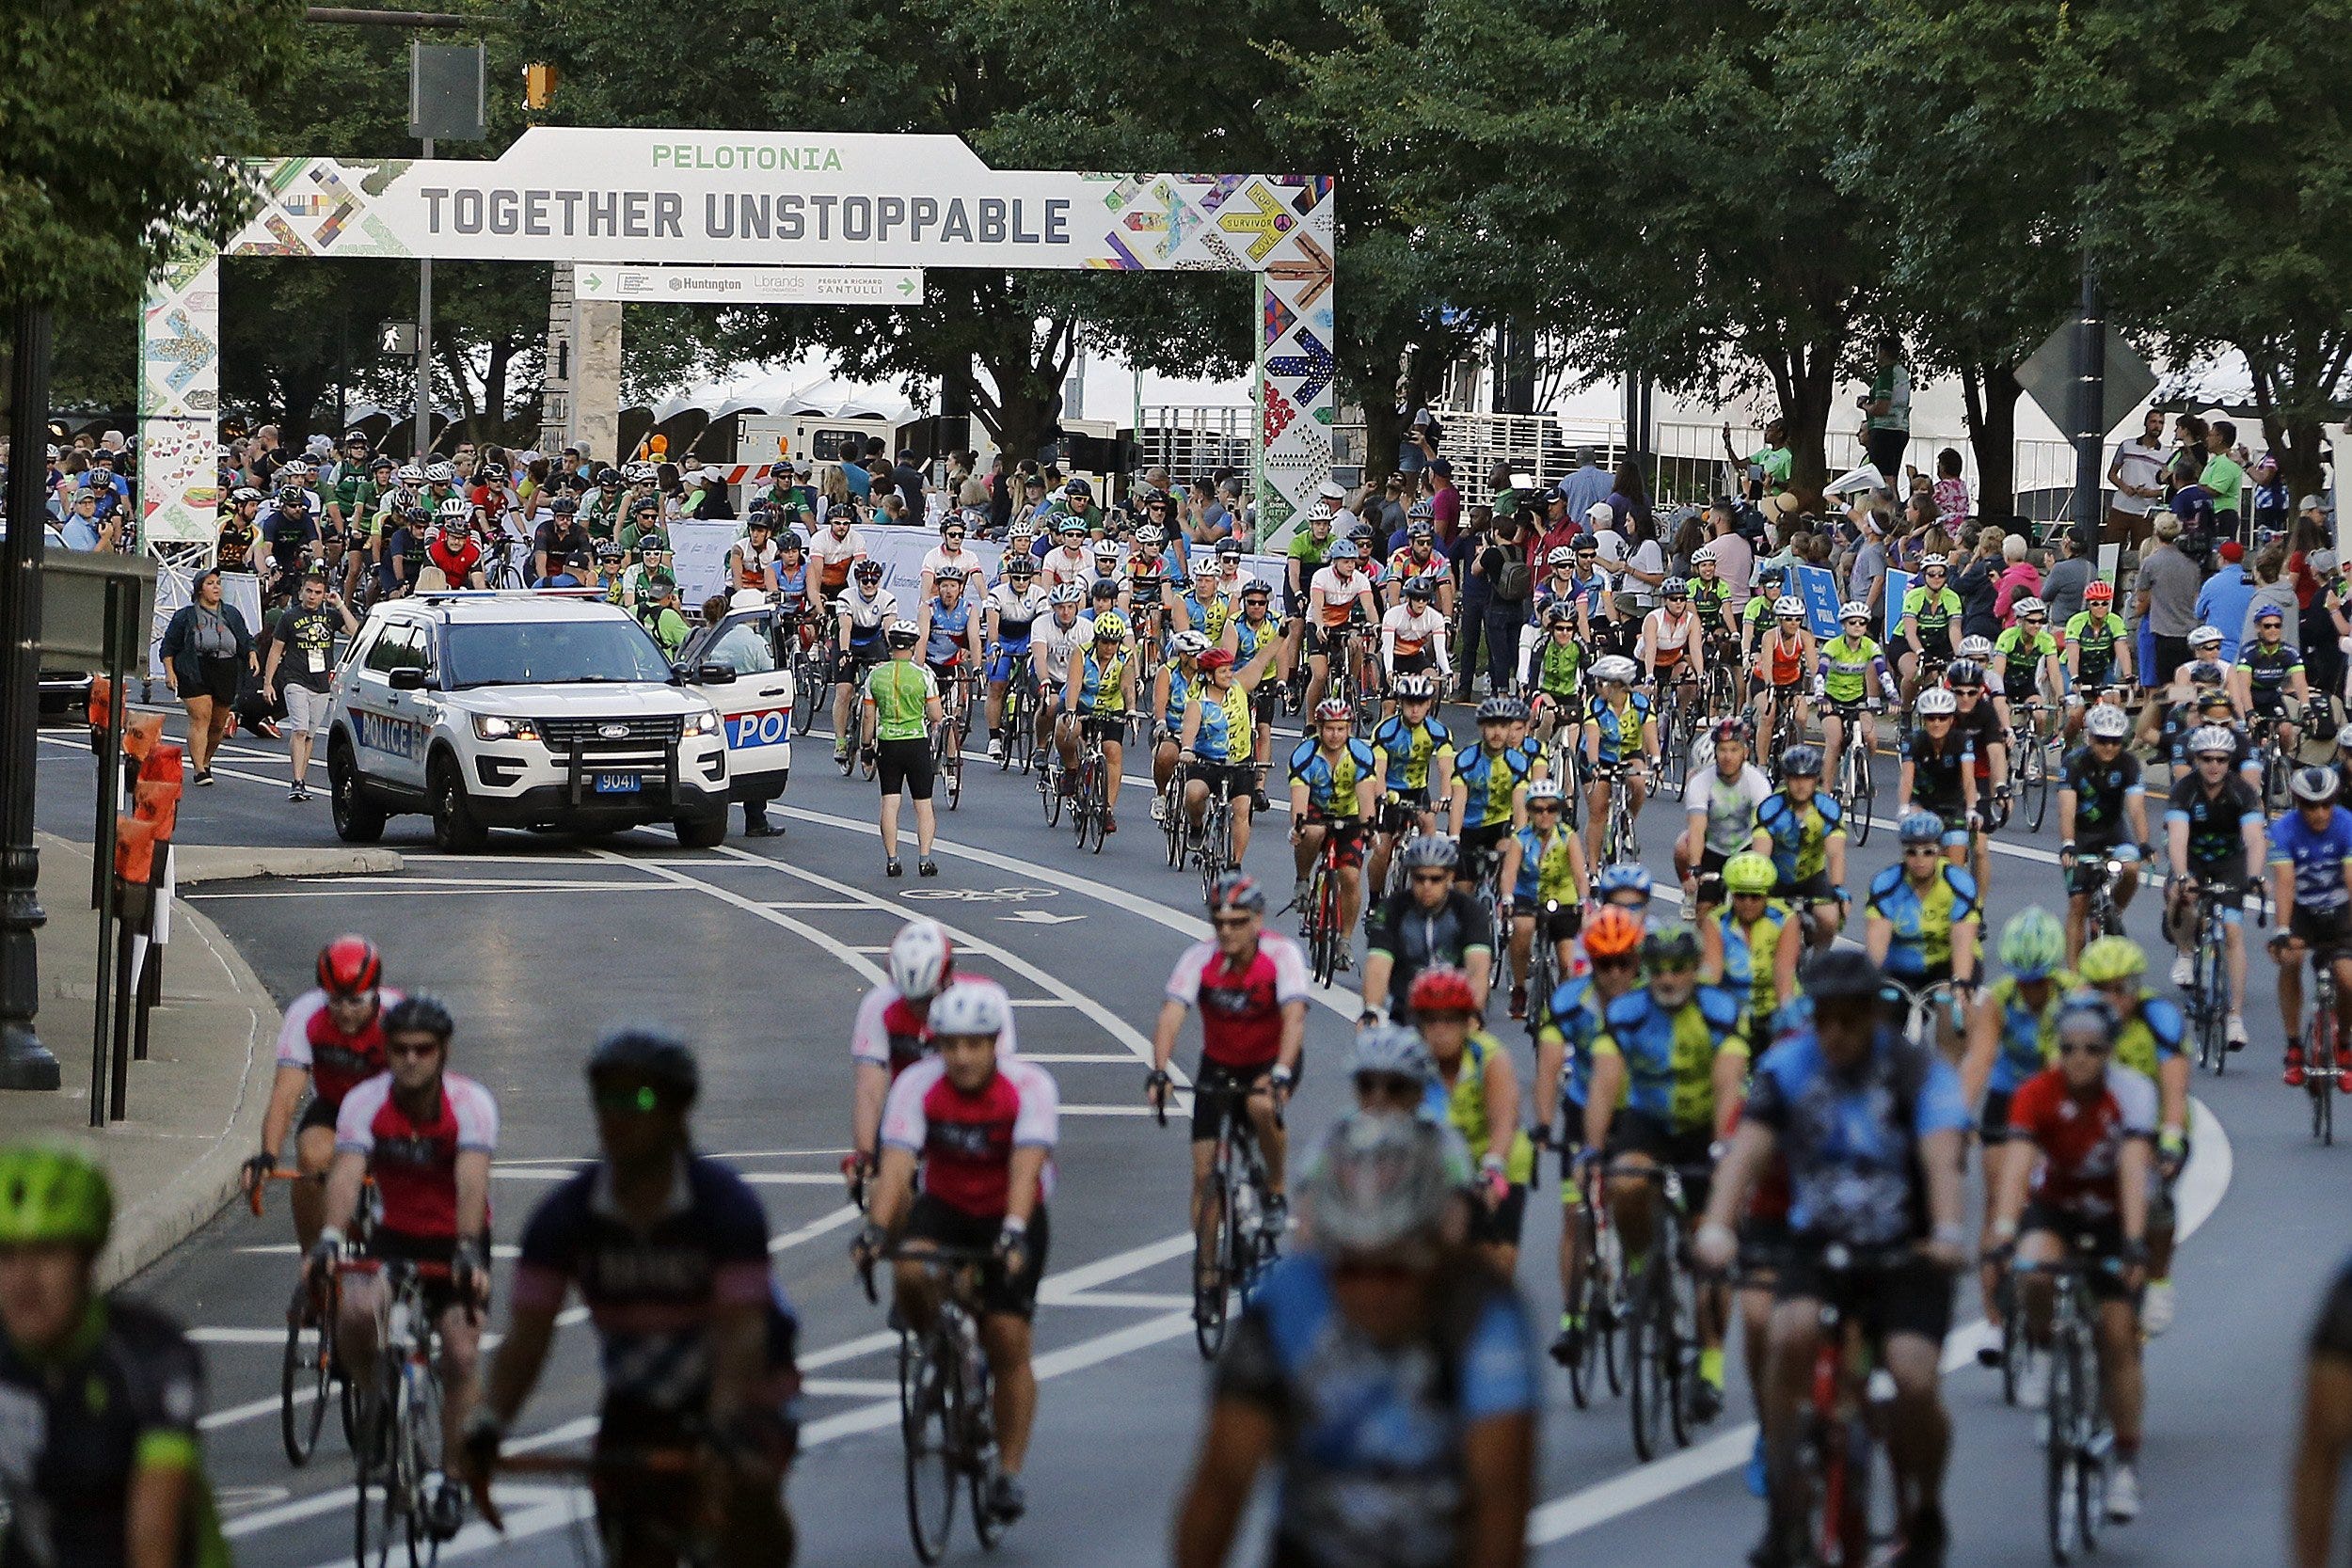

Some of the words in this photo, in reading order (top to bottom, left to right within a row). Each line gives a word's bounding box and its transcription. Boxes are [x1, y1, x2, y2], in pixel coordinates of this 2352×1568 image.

[652, 144, 842, 171] PELOTONIA
[1252, 190, 1274, 213] HOPE
[421, 187, 684, 238] TOGETHER
[705, 193, 1071, 244] UNSTOPPABLE
[1227, 219, 1272, 228] SURVIVOR
[1255, 233, 1277, 256] LOVE
[683, 277, 741, 292] Huntington
[818, 285, 882, 293] SANTULLI
[294, 616, 310, 629] ONE
[362, 712, 408, 754] POLICE
[1222, 700, 1238, 758] SPRING
[602, 774, 634, 789] 9041
